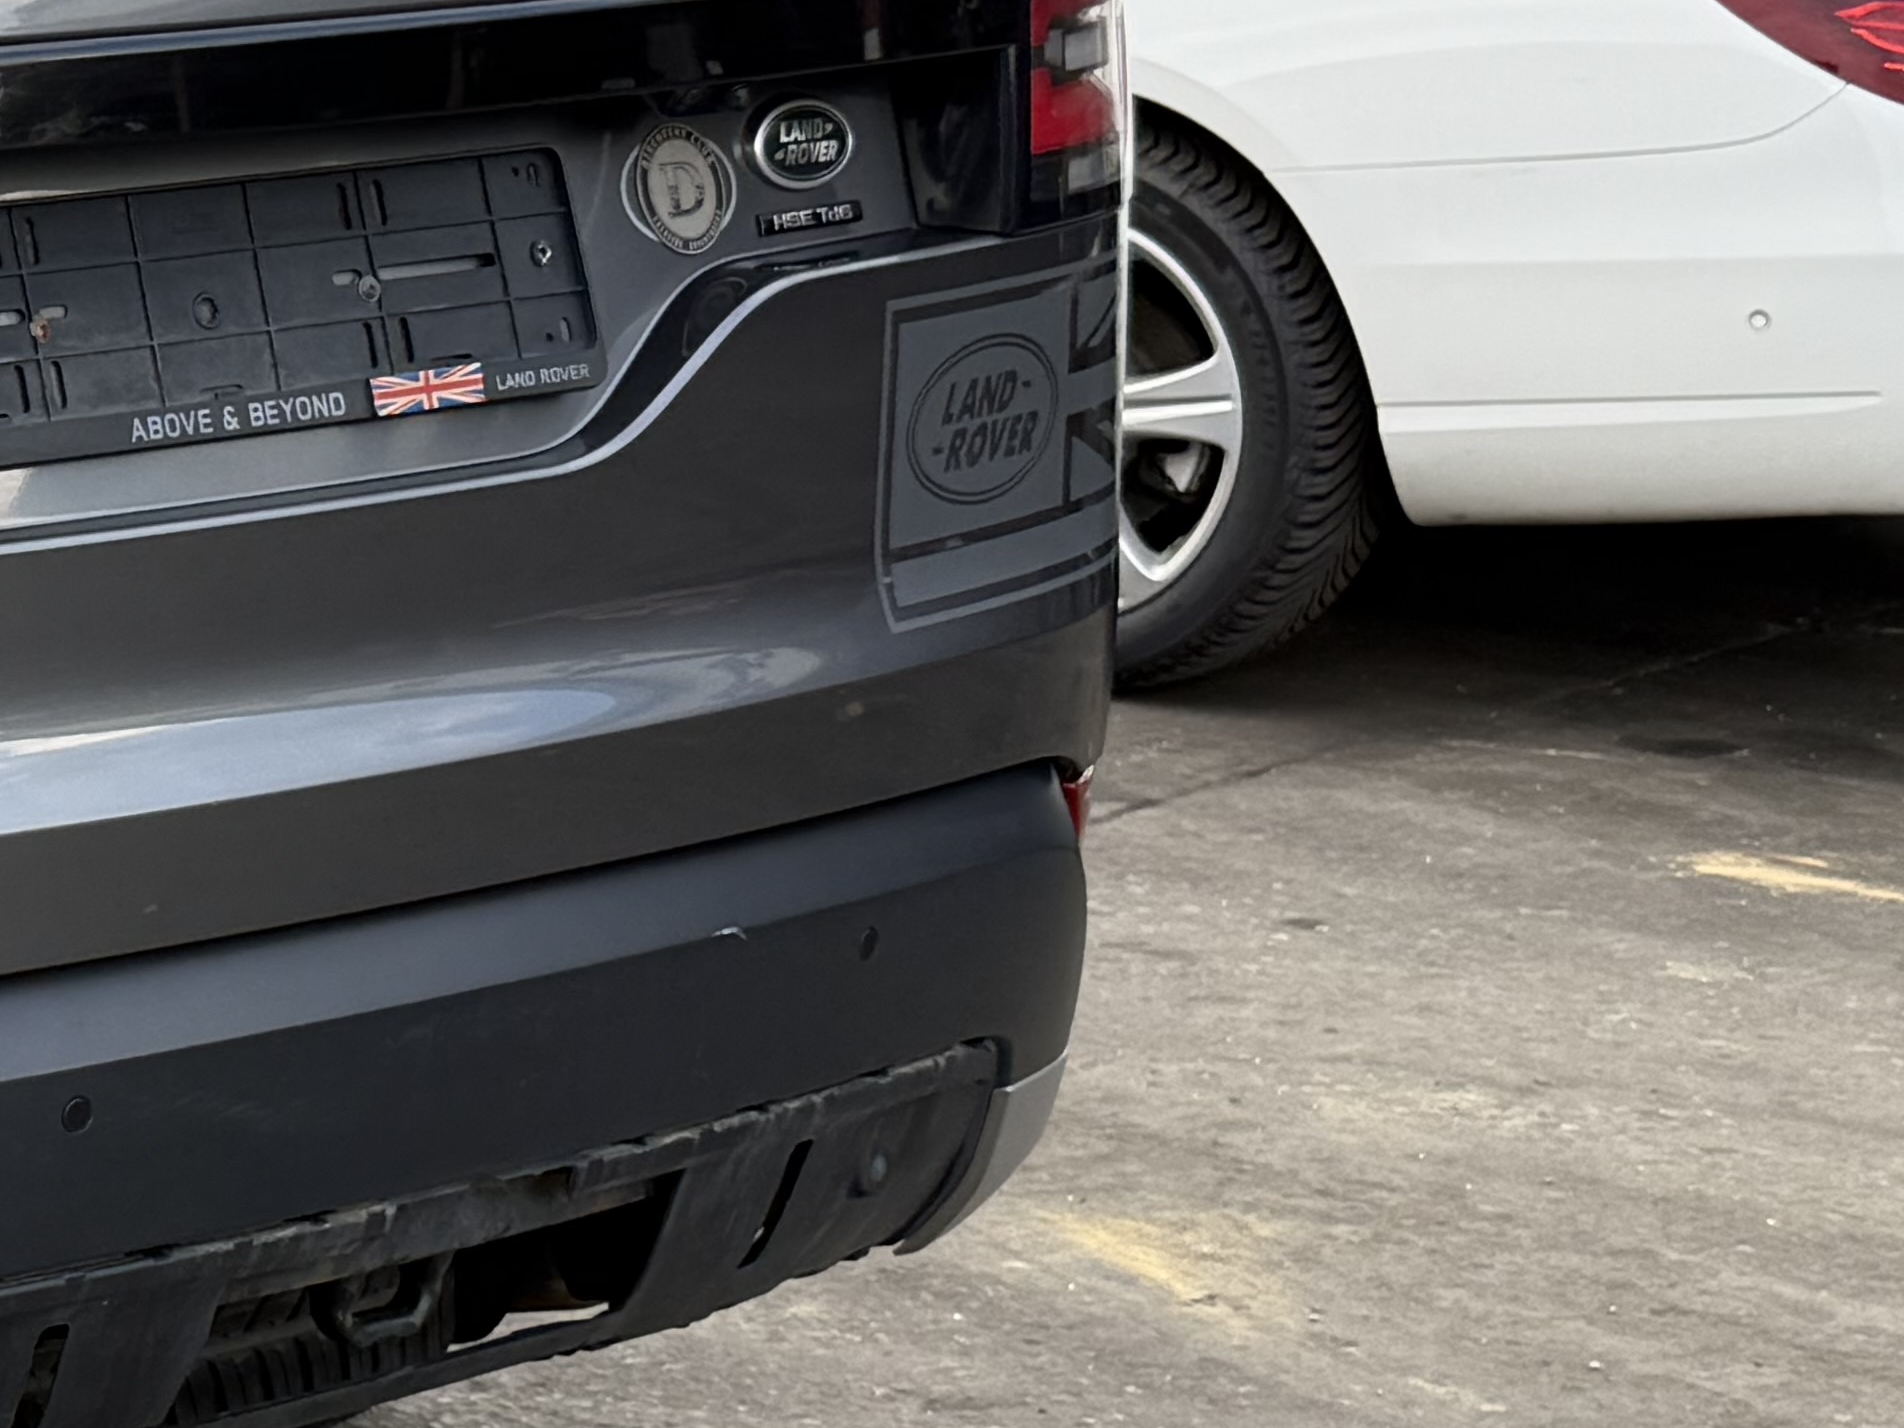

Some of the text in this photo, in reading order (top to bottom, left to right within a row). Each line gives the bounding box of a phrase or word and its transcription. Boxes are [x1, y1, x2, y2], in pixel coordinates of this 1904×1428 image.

[779, 118, 824, 143] LAND
[785, 139, 840, 167] ROVER
[773, 209, 816, 231] HSE
[131, 363, 591, 443] ABOVE & BEYOND LAND ROVER
[942, 369, 1018, 426] LAND
[943, 410, 1040, 473] ROVER
